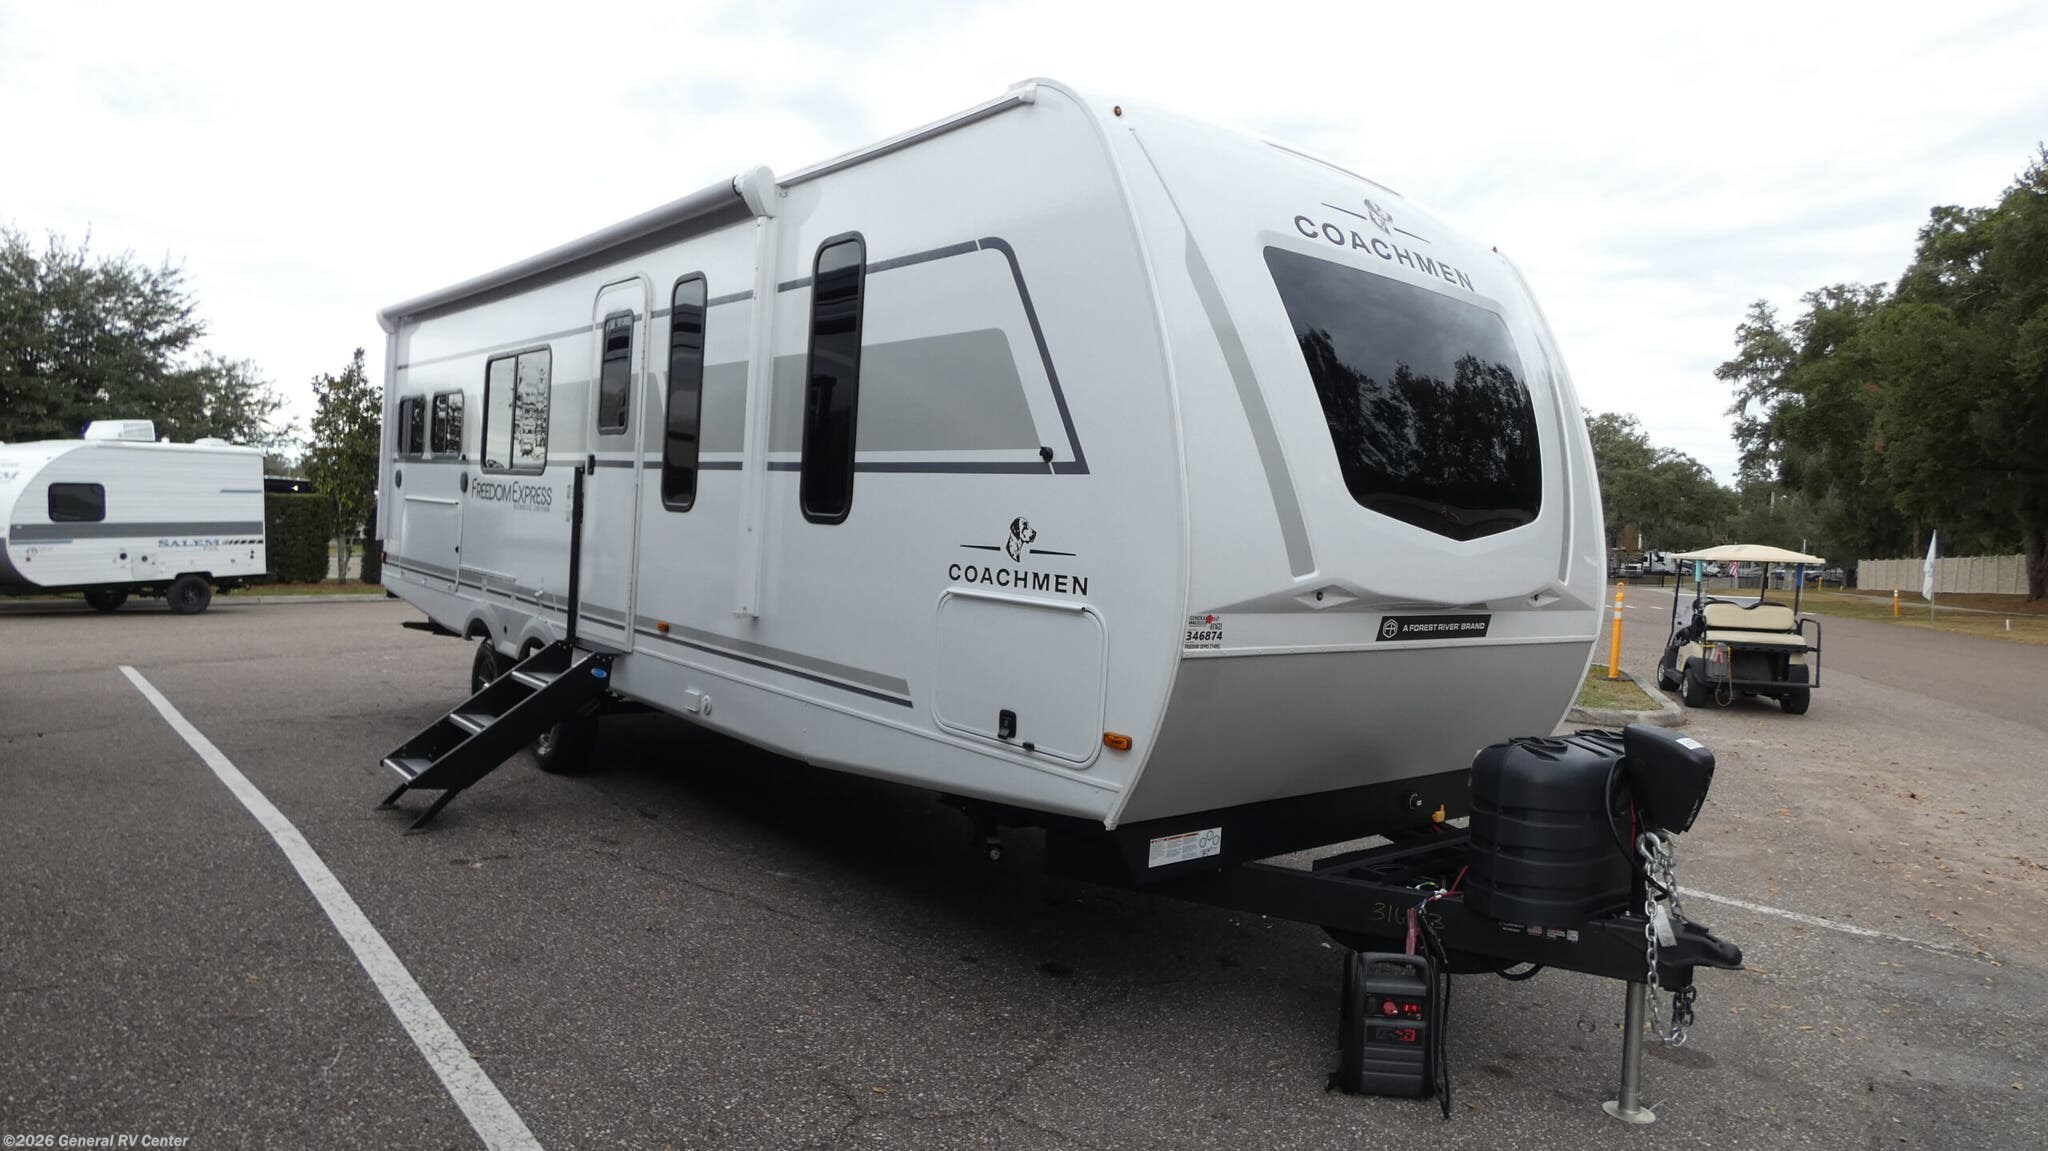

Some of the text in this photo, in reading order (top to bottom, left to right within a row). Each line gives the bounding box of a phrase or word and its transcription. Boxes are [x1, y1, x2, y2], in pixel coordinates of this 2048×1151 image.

[1294, 215, 1475, 291] COACHMEN
[158, 539, 219, 548] SALEM
[948, 563, 1089, 596] COACHMEN
[1402, 622, 1485, 632] A FOREST RIVER BRAND
[1186, 631, 1222, 641] 346874
